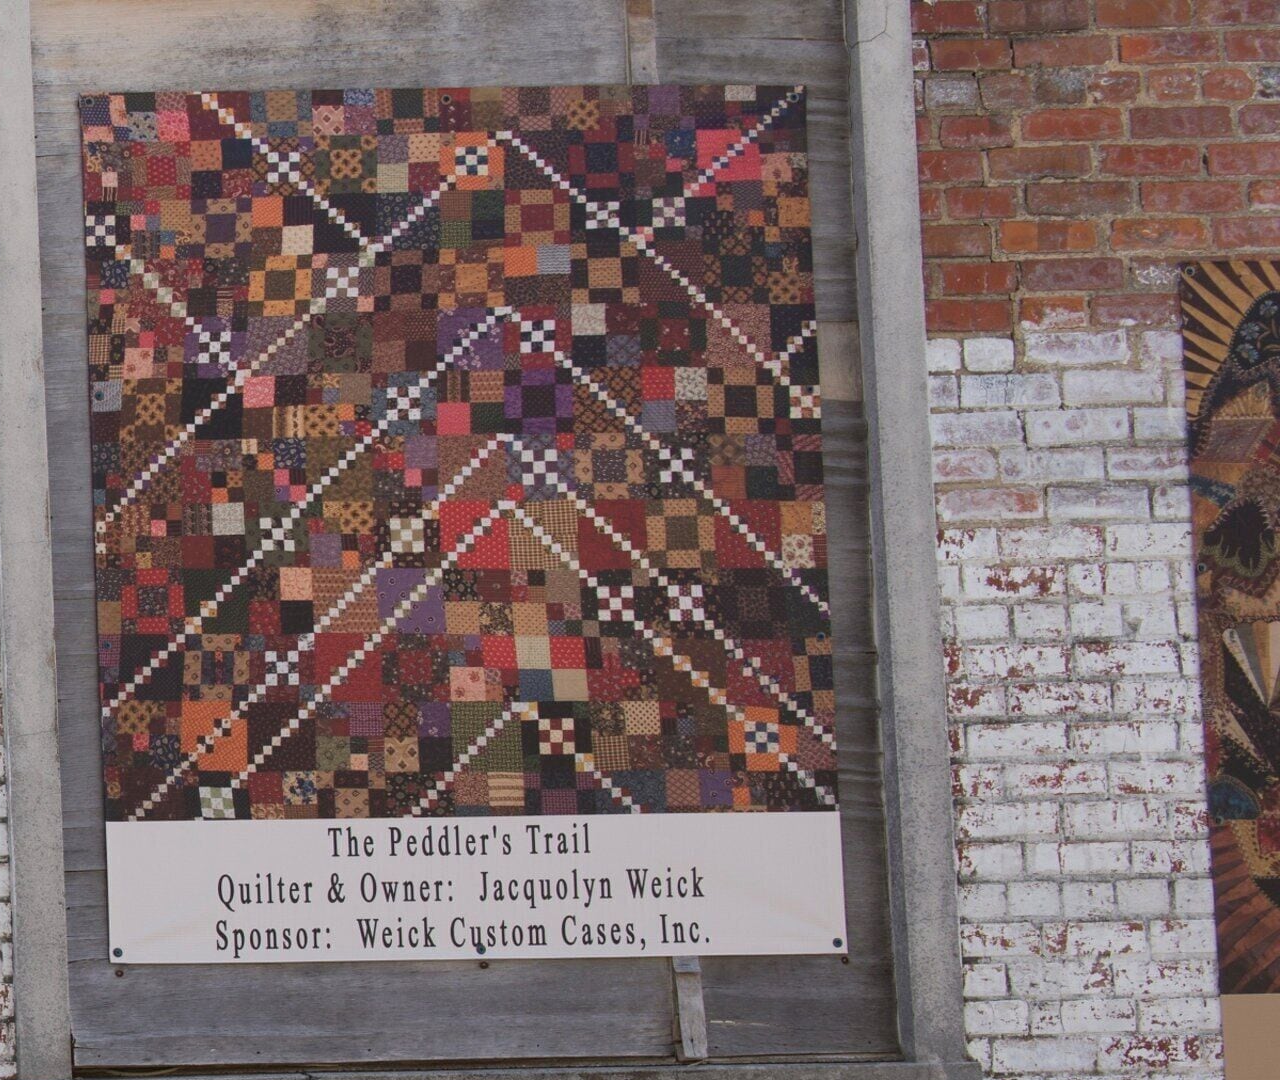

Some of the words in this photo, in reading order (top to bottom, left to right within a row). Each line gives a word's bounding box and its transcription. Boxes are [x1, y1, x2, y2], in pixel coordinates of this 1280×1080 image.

[327, 826, 374, 858] The
[388, 824, 512, 857] Peddler's
[525, 822, 591, 855] Trail
[217, 872, 313, 911] Quilter
[327, 872, 346, 904] &
[360, 872, 453, 903] Owner:
[479, 868, 613, 909] Jacquolyn
[625, 866, 705, 899] Weick
[215, 919, 331, 959] Sponsor:
[356, 916, 437, 949] Weick
[450, 916, 548, 948] Custom
[561, 915, 646, 951] Cases,
[659, 913, 710, 944] Inc.
